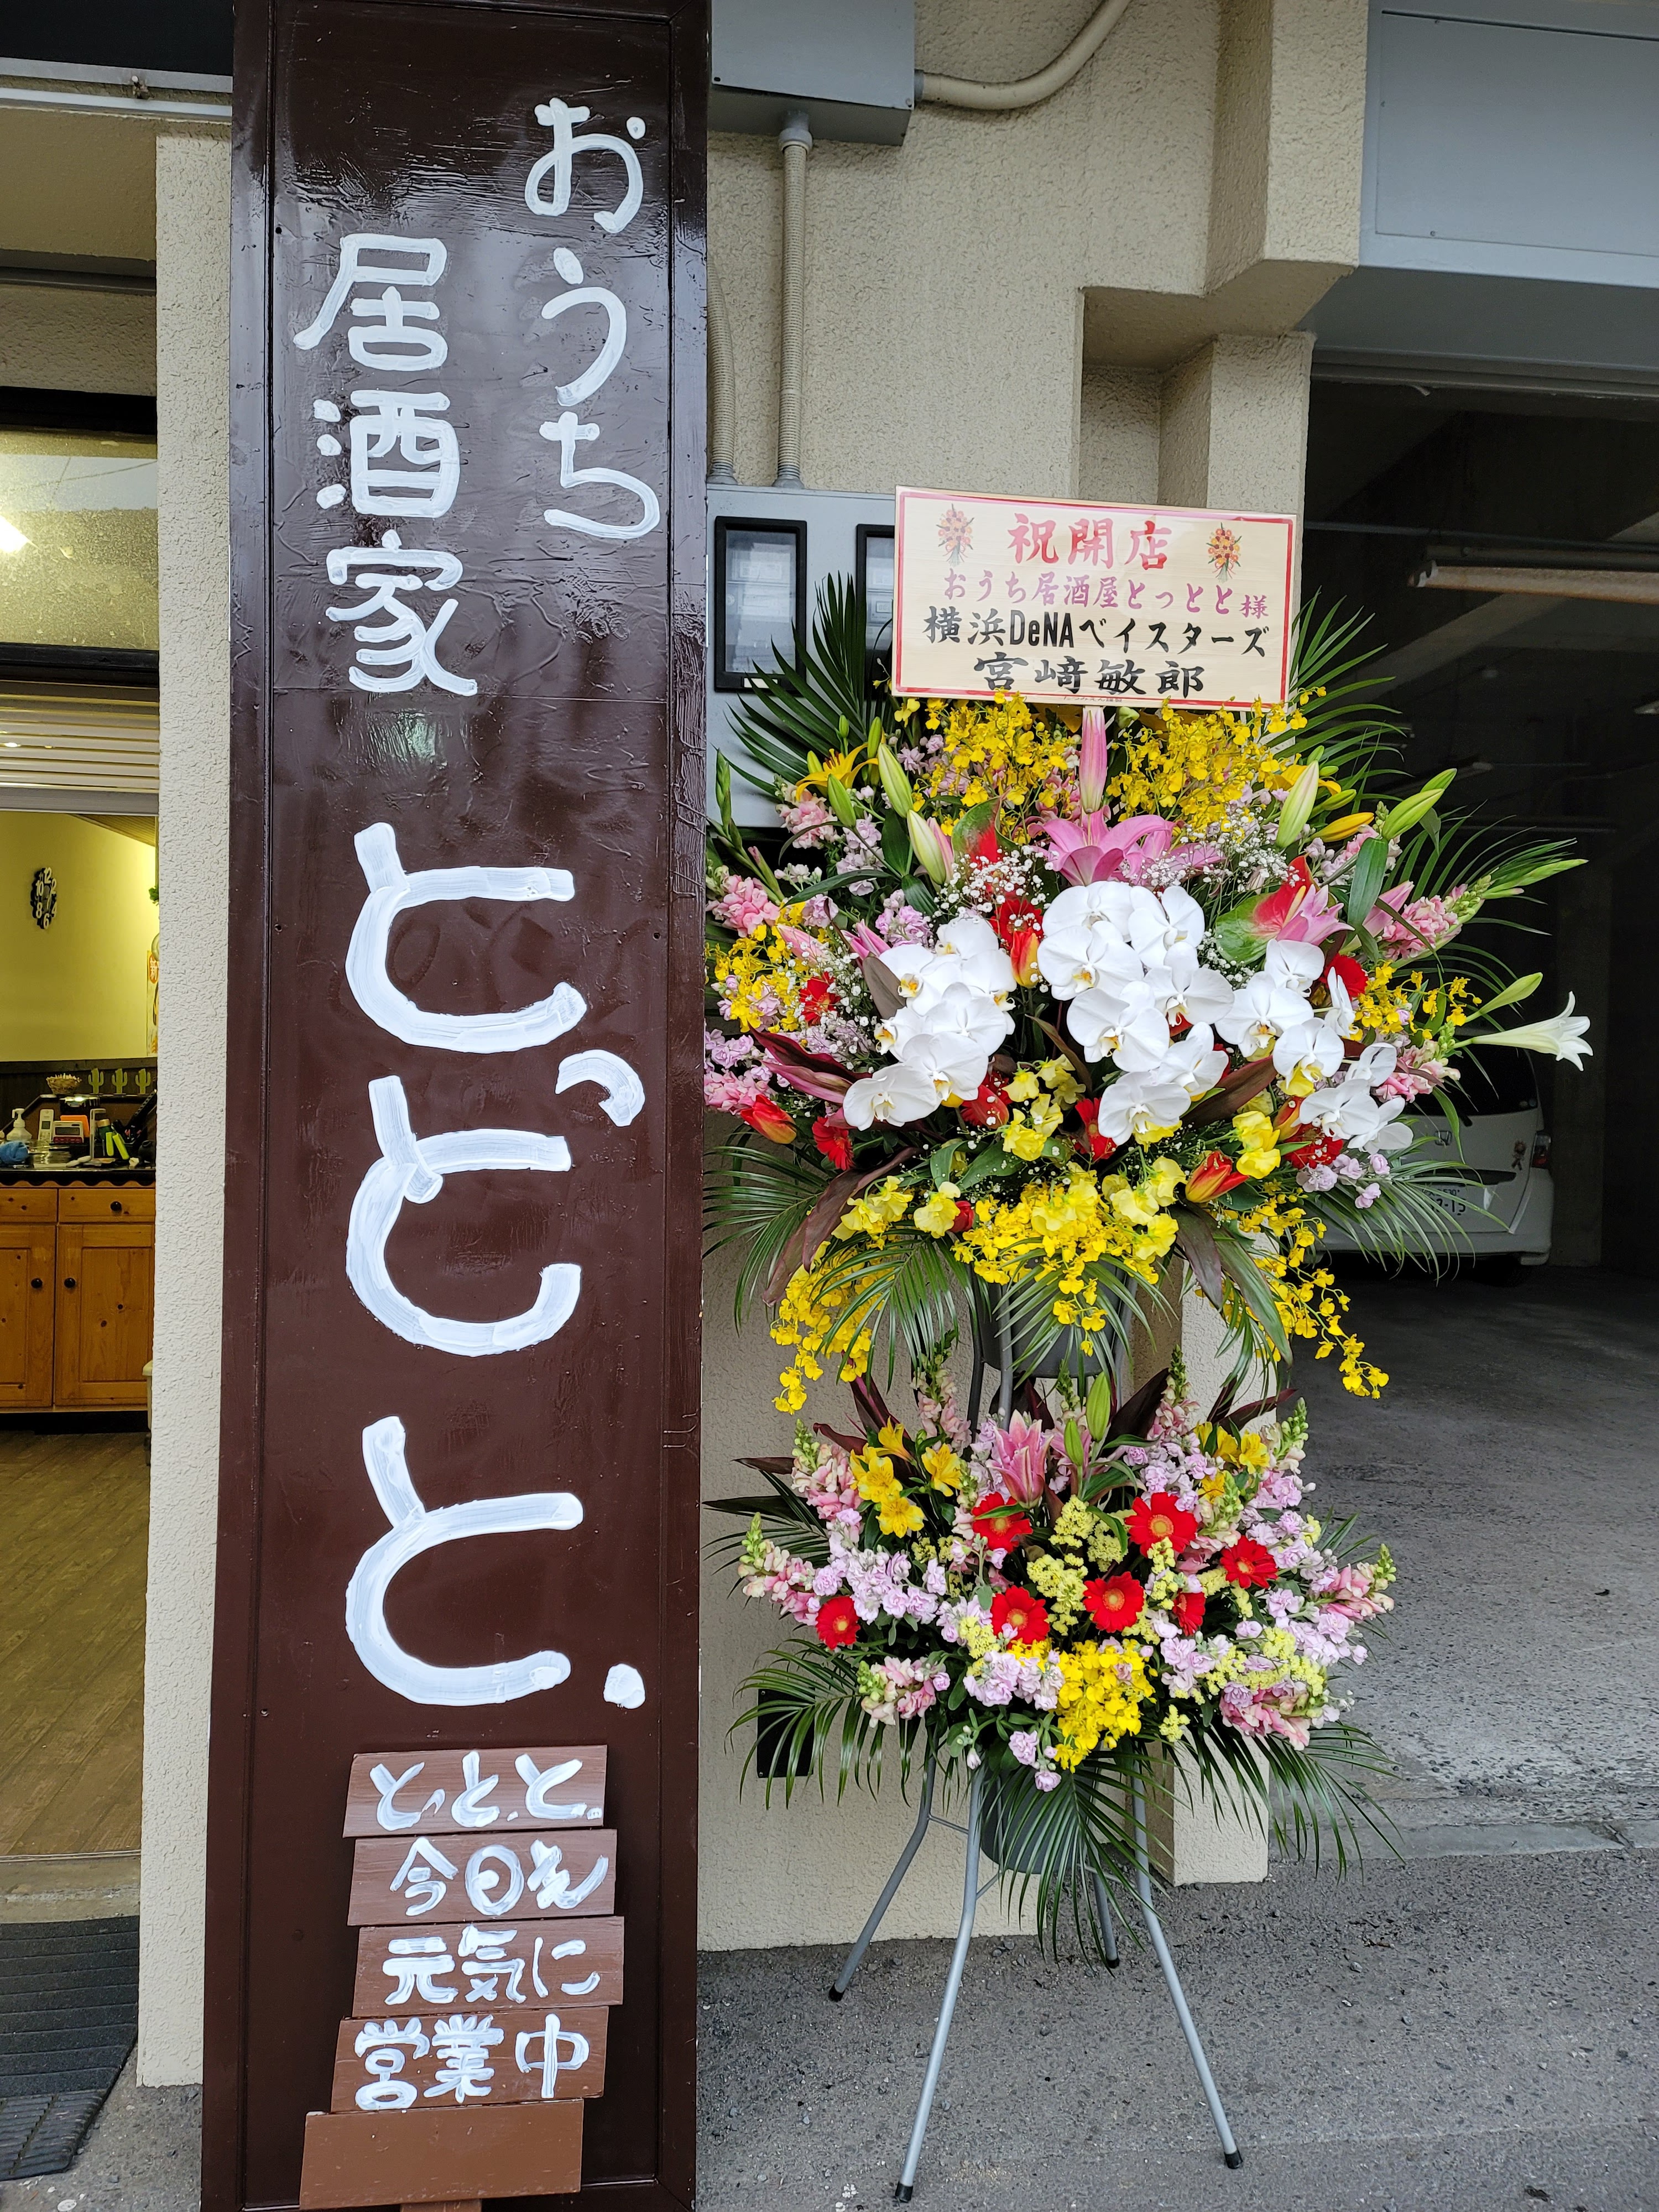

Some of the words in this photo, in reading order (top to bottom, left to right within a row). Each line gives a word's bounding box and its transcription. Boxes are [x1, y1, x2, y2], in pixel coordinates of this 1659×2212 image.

[525, 98, 660, 539] おうち
[293, 233, 478, 696] 居酒家
[1008, 512, 1172, 570] 祝開店
[943, 570, 1269, 619] おうち居酒屋とっとと様
[922, 605, 1269, 658] 横浜DeNAベイスターズ
[35, 880, 44, 896] 10
[44, 867, 52, 884] 12
[36, 902, 43, 918] 8
[44, 913, 50, 929] 6
[382, 1923, 601, 2005] 元気に
[354, 2013, 590, 2111] 営業中
